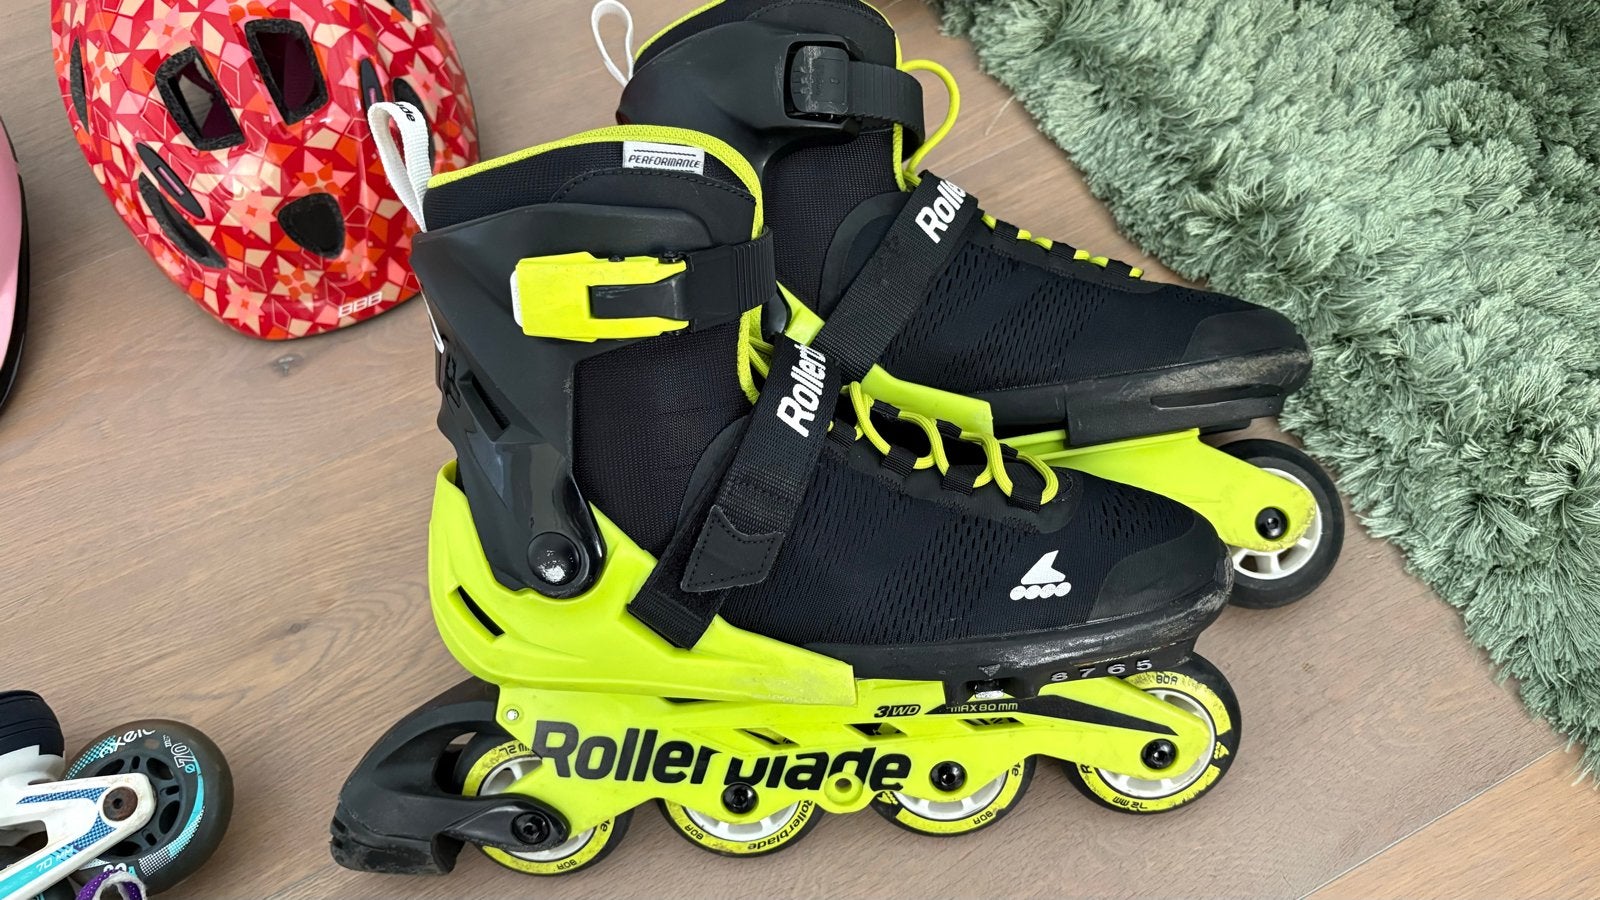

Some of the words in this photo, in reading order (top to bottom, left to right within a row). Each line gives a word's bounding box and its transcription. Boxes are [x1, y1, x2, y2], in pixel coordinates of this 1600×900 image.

[628, 154, 700, 169] PERFORMANCE
[338, 291, 382, 318] BBB
[1051, 671, 1068, 682] 8
[1080, 667, 1096, 679] 7
[1107, 663, 1126, 675] 6
[1136, 659, 1153, 671] 5
[874, 704, 921, 718] 3WD
[979, 704, 996, 712] 80
[998, 702, 1018, 711] MM
